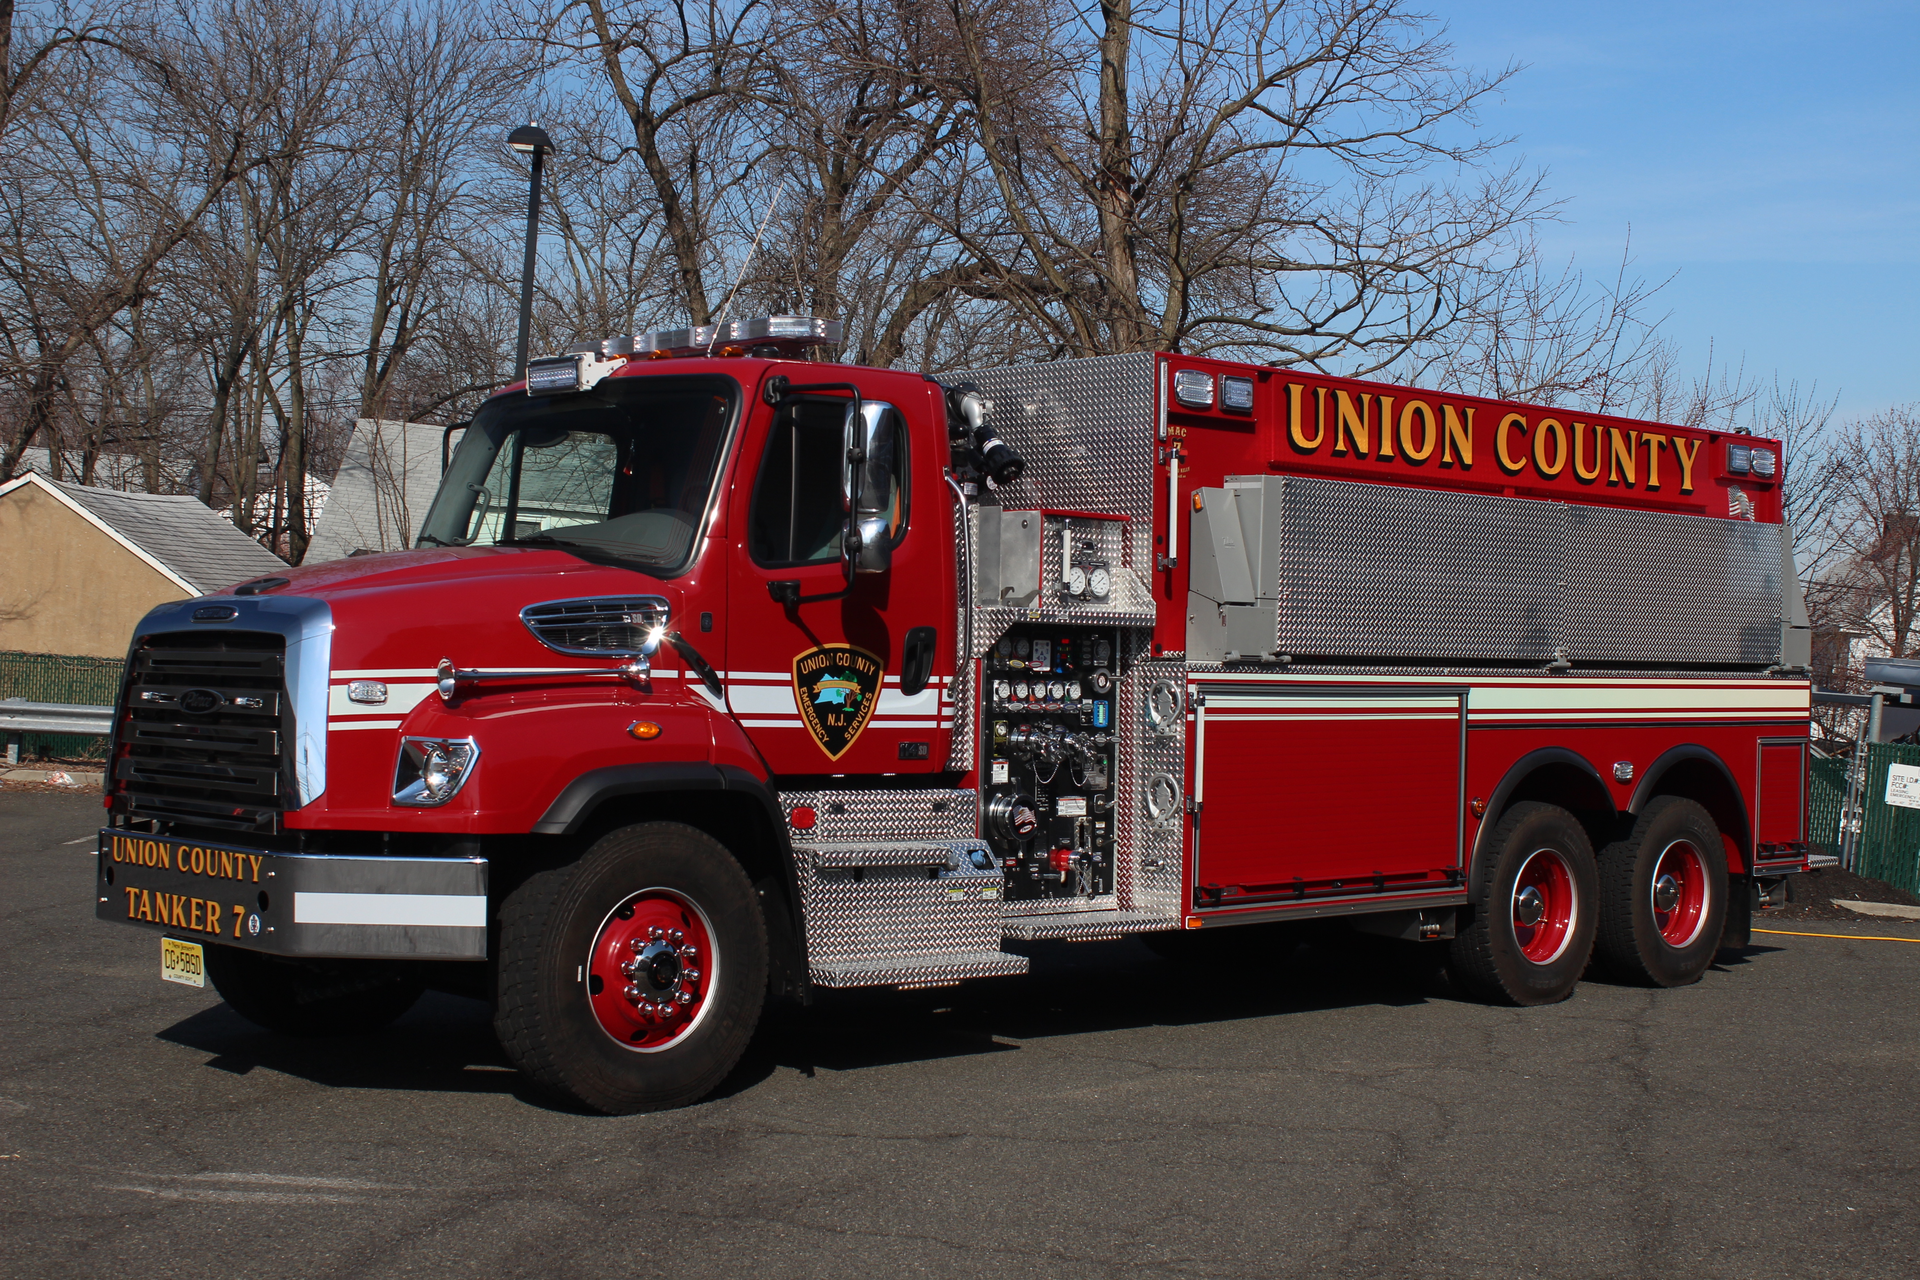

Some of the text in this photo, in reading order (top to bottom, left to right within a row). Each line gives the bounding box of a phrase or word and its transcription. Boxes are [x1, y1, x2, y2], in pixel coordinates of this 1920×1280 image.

[1168, 427, 1187, 437] MAC
[1286, 382, 1703, 494] UNION COUNTY
[800, 652, 877, 676] UNION COUNTY
[799, 686, 830, 743] EMERGENCY
[827, 713, 847, 727] N.J.
[844, 692, 873, 741] SERVICES
[112, 836, 263, 883] UNION COUNTY
[125, 886, 222, 935] TANKER
[233, 904, 246, 938] 7
